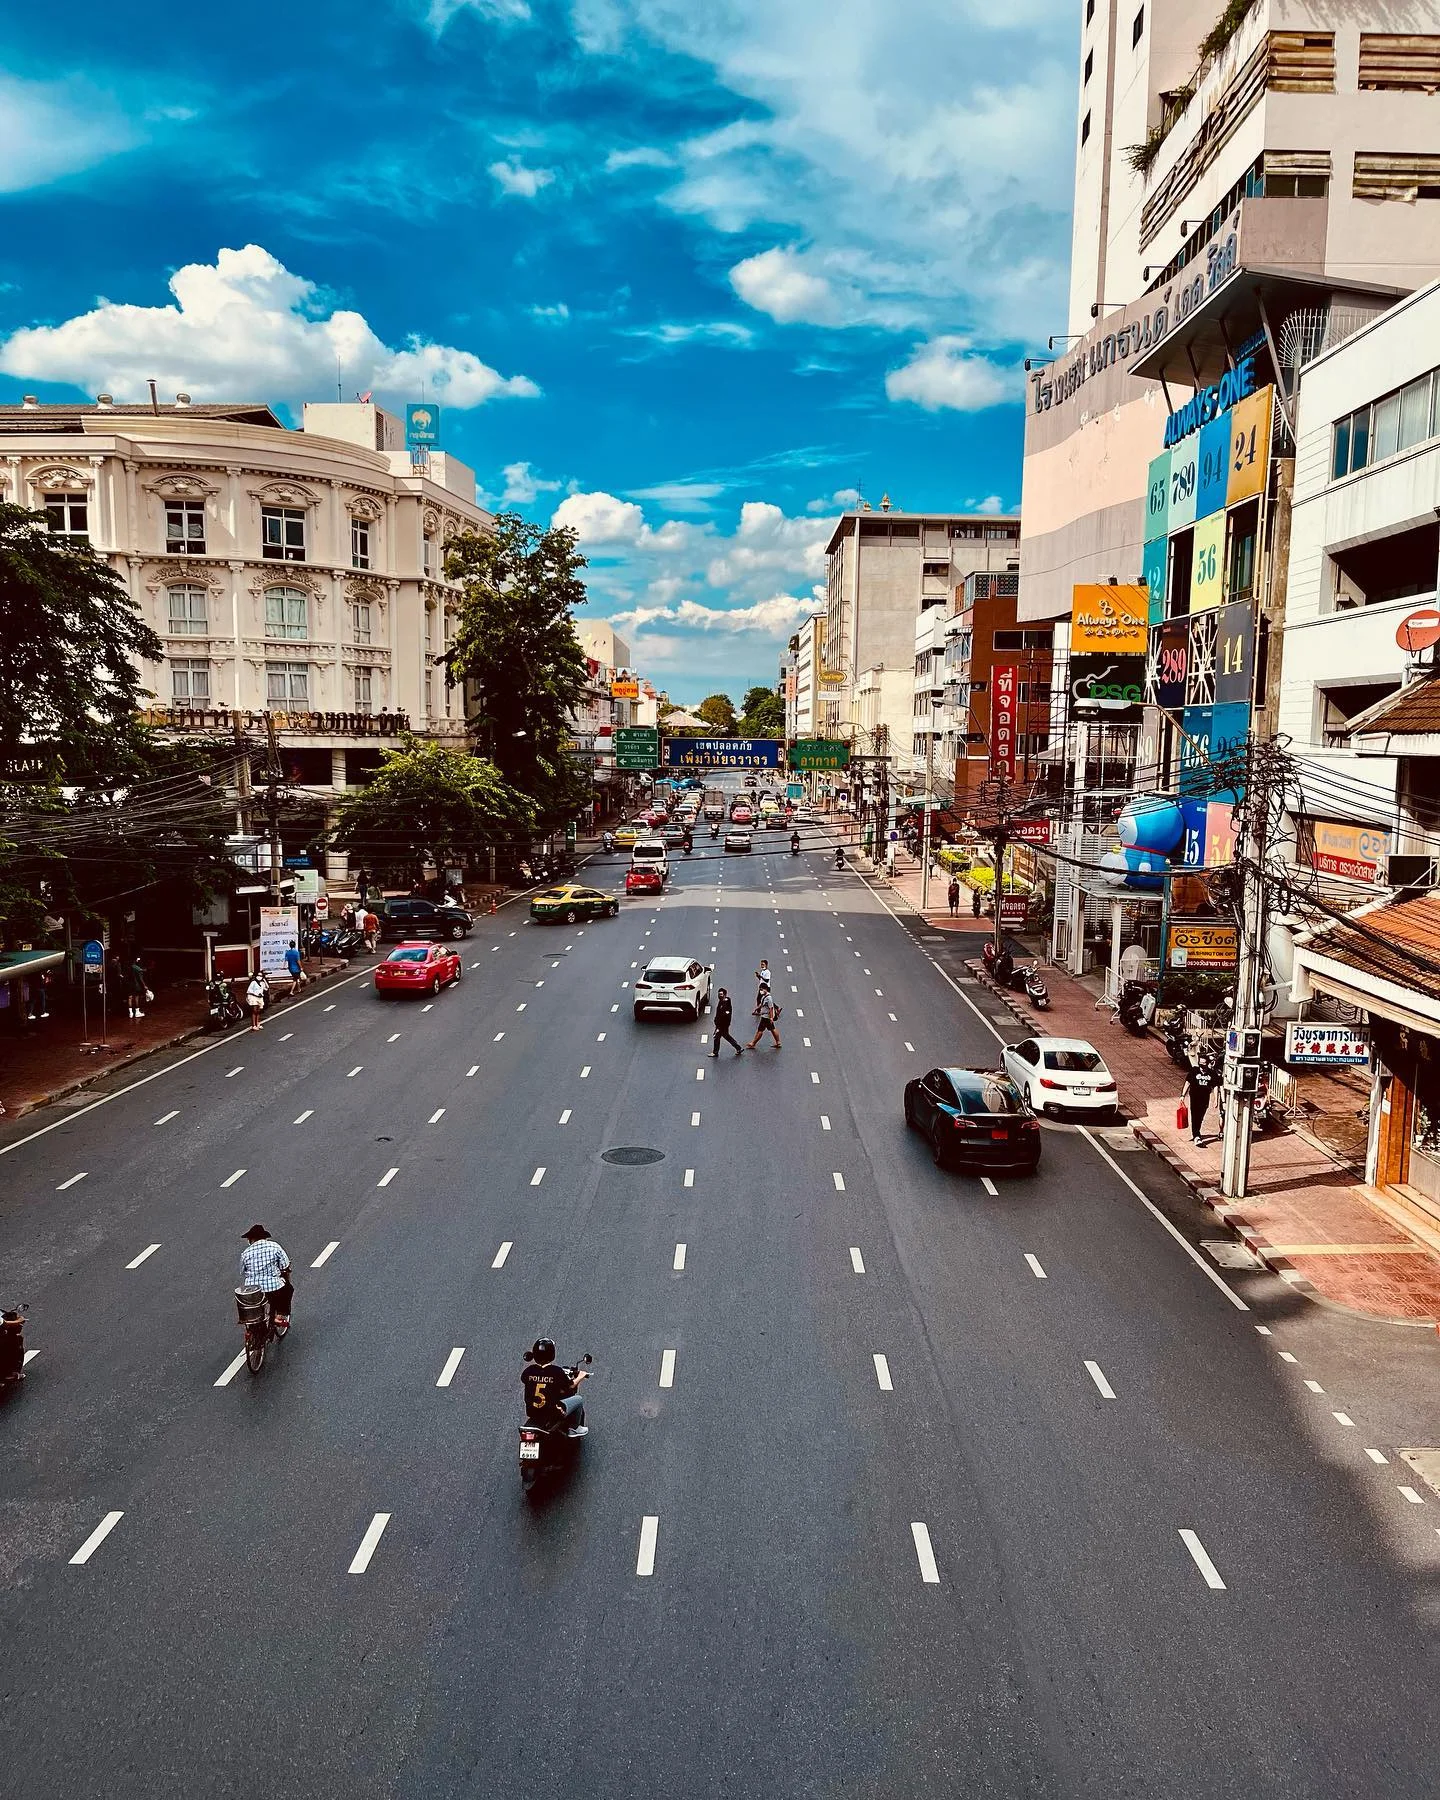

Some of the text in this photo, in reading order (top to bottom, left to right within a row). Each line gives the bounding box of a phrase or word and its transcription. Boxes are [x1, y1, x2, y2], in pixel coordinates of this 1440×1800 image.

[1031, 352, 1086, 413] โรงแรม
[1163, 358, 1256, 449] ALWAYS ONE
[1234, 424, 1257, 472] 24
[1172, 461, 1195, 506] 789
[1203, 446, 1223, 490] 94
[1150, 479, 1165, 515] 65
[1198, 543, 1216, 585] 56
[1077, 611, 1146, 628] Always One
[1161, 648, 1186, 683] 289
[1222, 634, 1243, 675] 14
[1090, 684, 1141, 702] PSG
[680, 749, 768, 766] เพิ่มวินัยจราจร
[695, 740, 752, 751] เขตปลอดภัย
[1319, 855, 1375, 880] บริการ ตรวจวัดสาย
[528, 1375, 554, 1383] POLICE
[533, 1383, 546, 1409] 5
